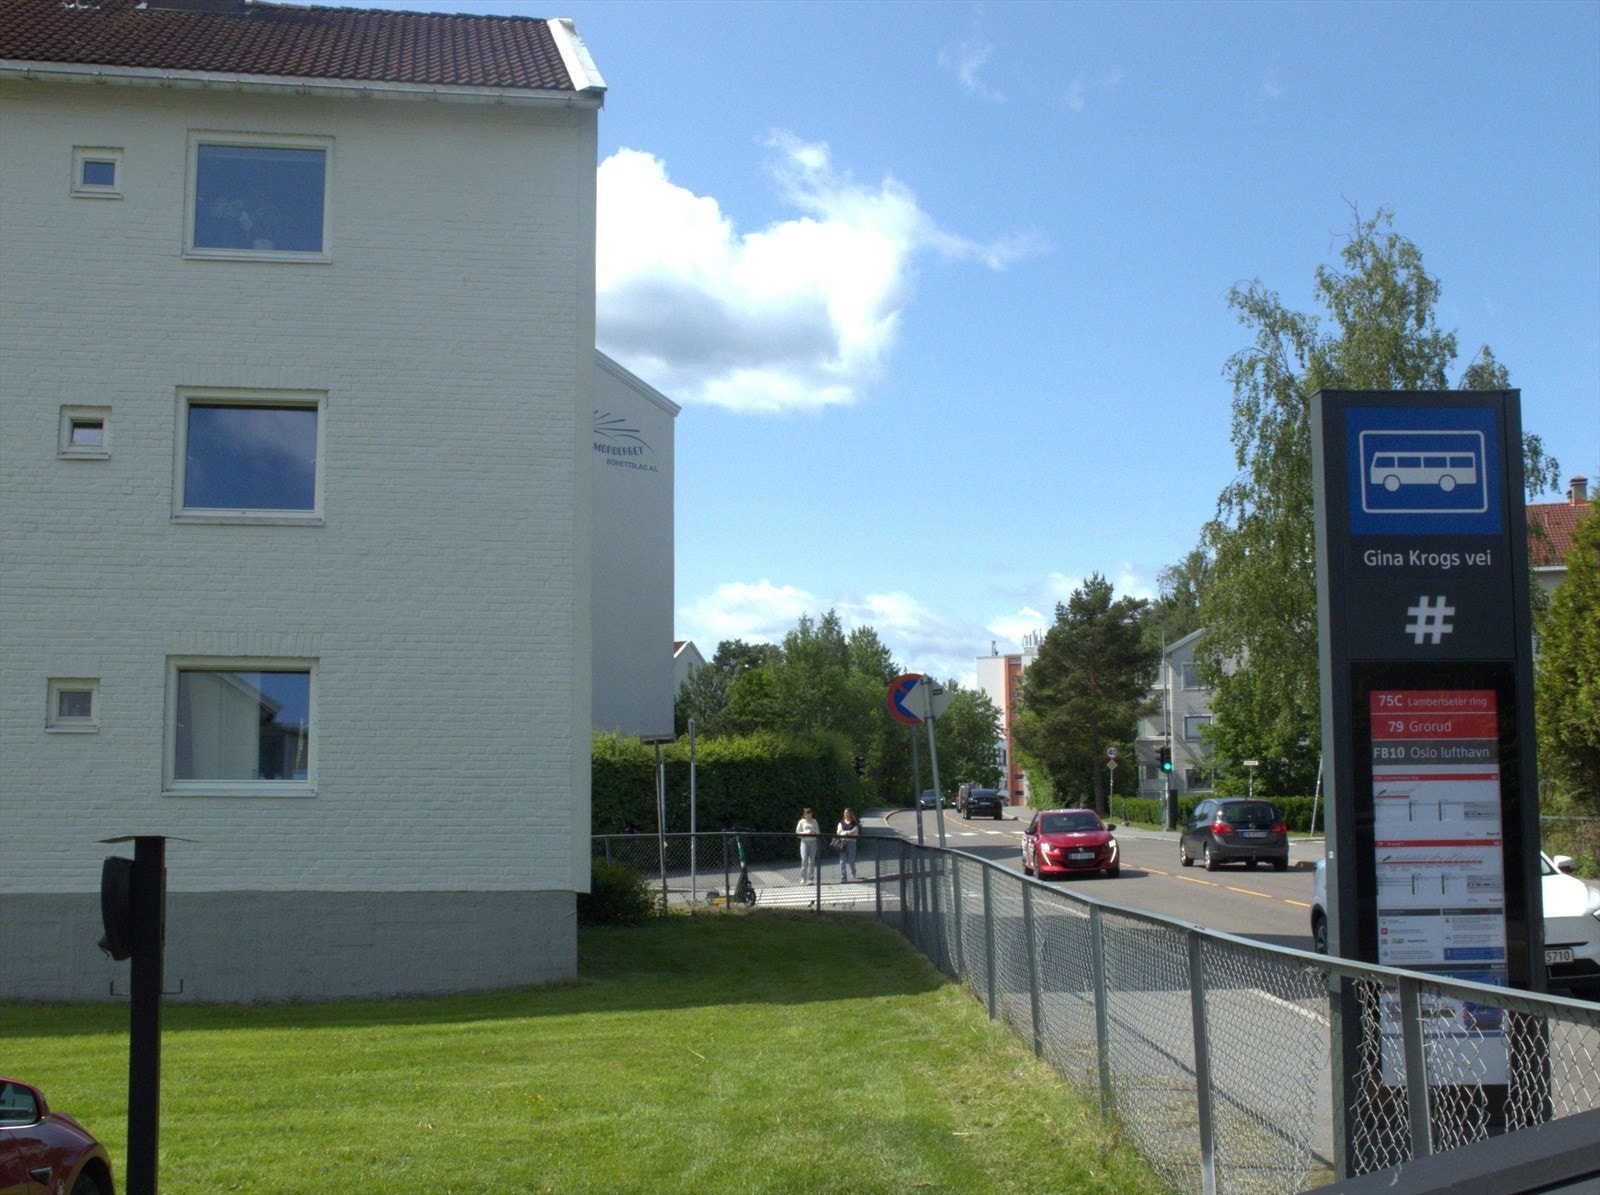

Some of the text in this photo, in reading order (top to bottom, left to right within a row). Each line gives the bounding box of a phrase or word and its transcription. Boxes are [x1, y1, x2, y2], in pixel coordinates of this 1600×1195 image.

[606, 459, 648, 471] BORETTSLAG
[1363, 550, 1491, 570] Gina Krogs vei
[1379, 695, 1487, 708] 75C Lambertseter ring
[1388, 721, 1452, 733] 79 Grorud
[1373, 746, 1490, 759] FB10 Oslo lufthavn
[1546, 951, 1570, 962] 5710
